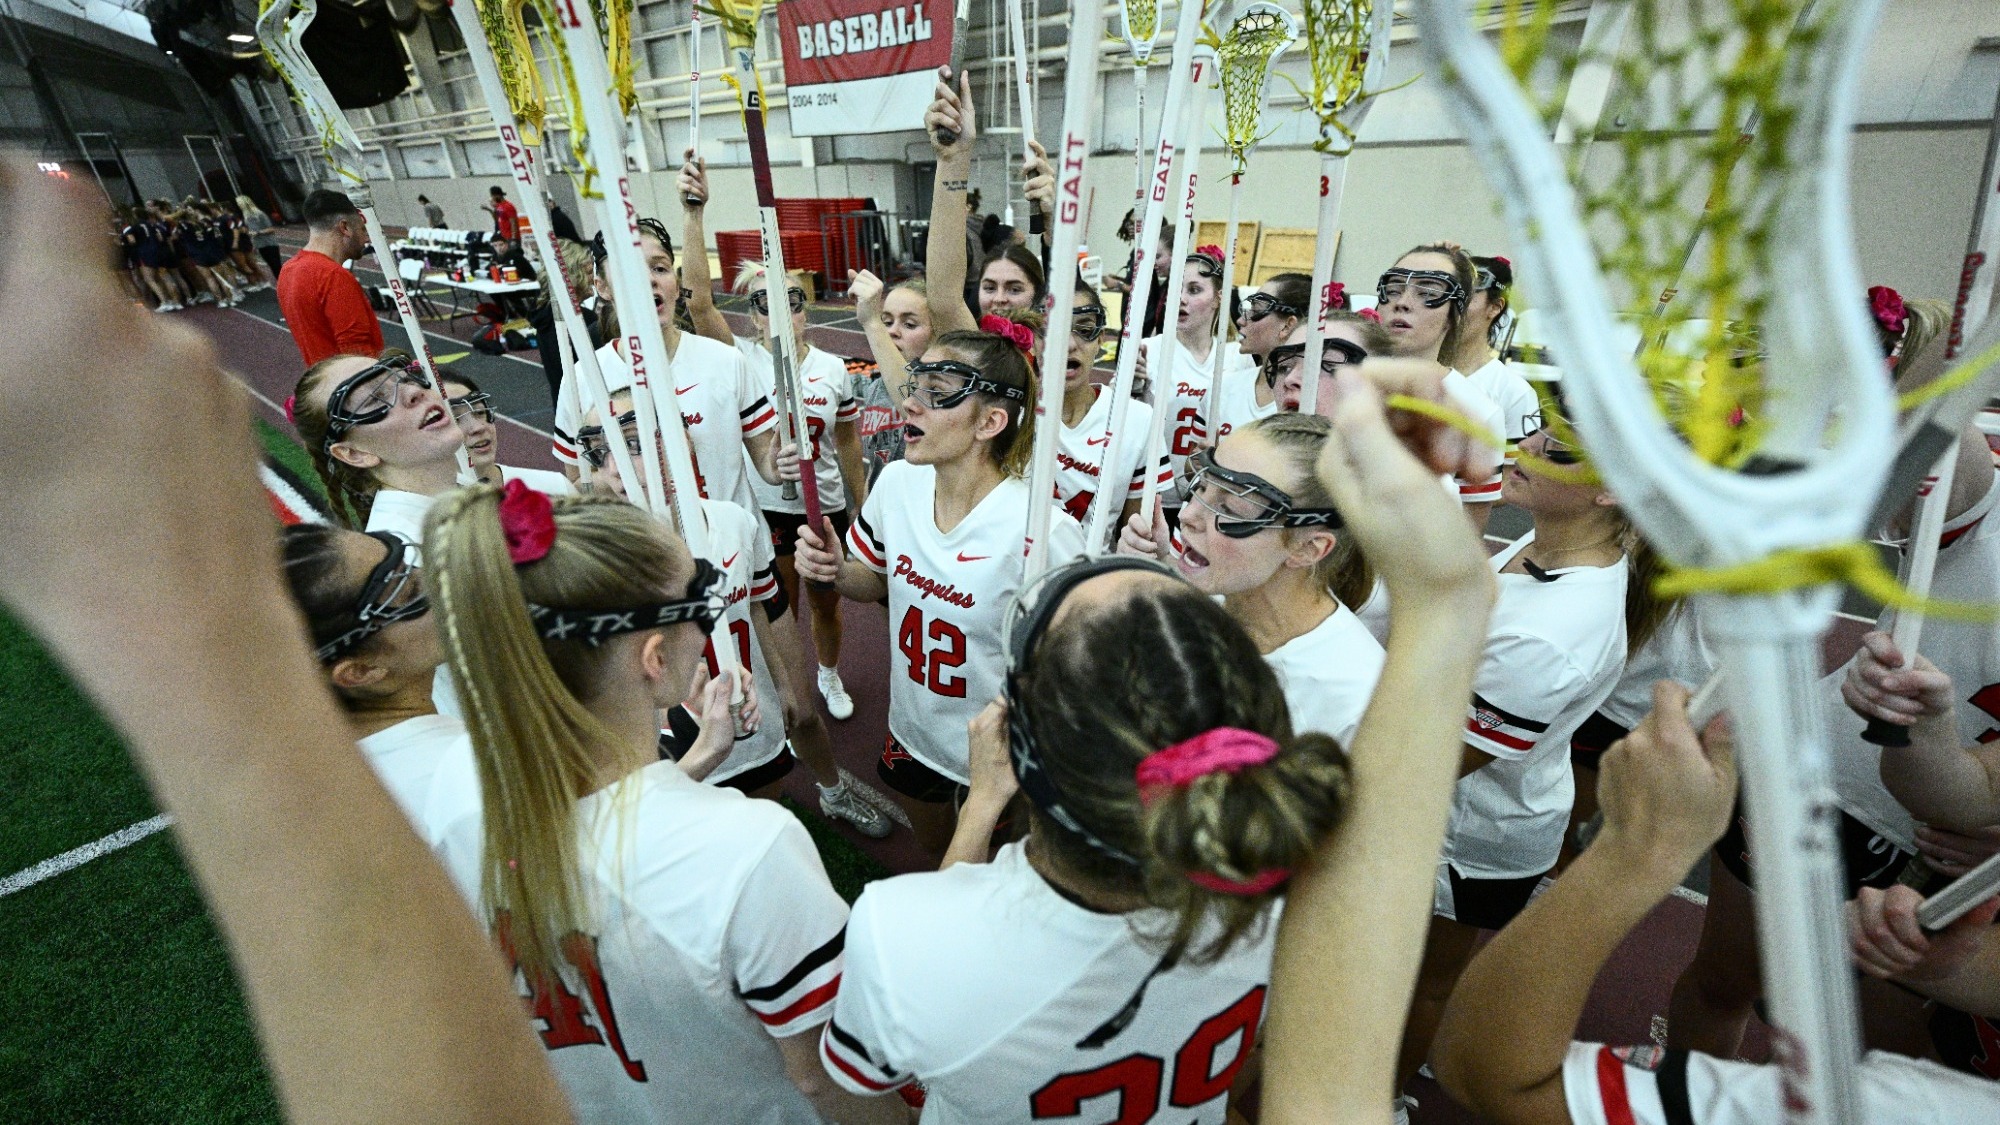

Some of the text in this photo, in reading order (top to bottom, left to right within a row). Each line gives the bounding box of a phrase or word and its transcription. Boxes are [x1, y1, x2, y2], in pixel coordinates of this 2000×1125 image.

[797, 3, 932, 59] BASEBALL
[792, 93, 838, 107] 2004 2014
[500, 125, 532, 186] GAIT
[1060, 131, 1084, 224] GAIT
[1152, 139, 1173, 202] GAIT
[618, 177, 643, 247] GAIT
[1184, 174, 1198, 220] GAIT
[389, 278, 412, 316] GAIT
[1317, 283, 1331, 333] GAIT
[628, 335, 649, 389] GAIT
[1176, 382, 1207, 402] Peng
[1057, 453, 1100, 477] nguin
[1287, 512, 1331, 525] TX
[893, 554, 975, 609] Penguins
[898, 604, 967, 698] 42
